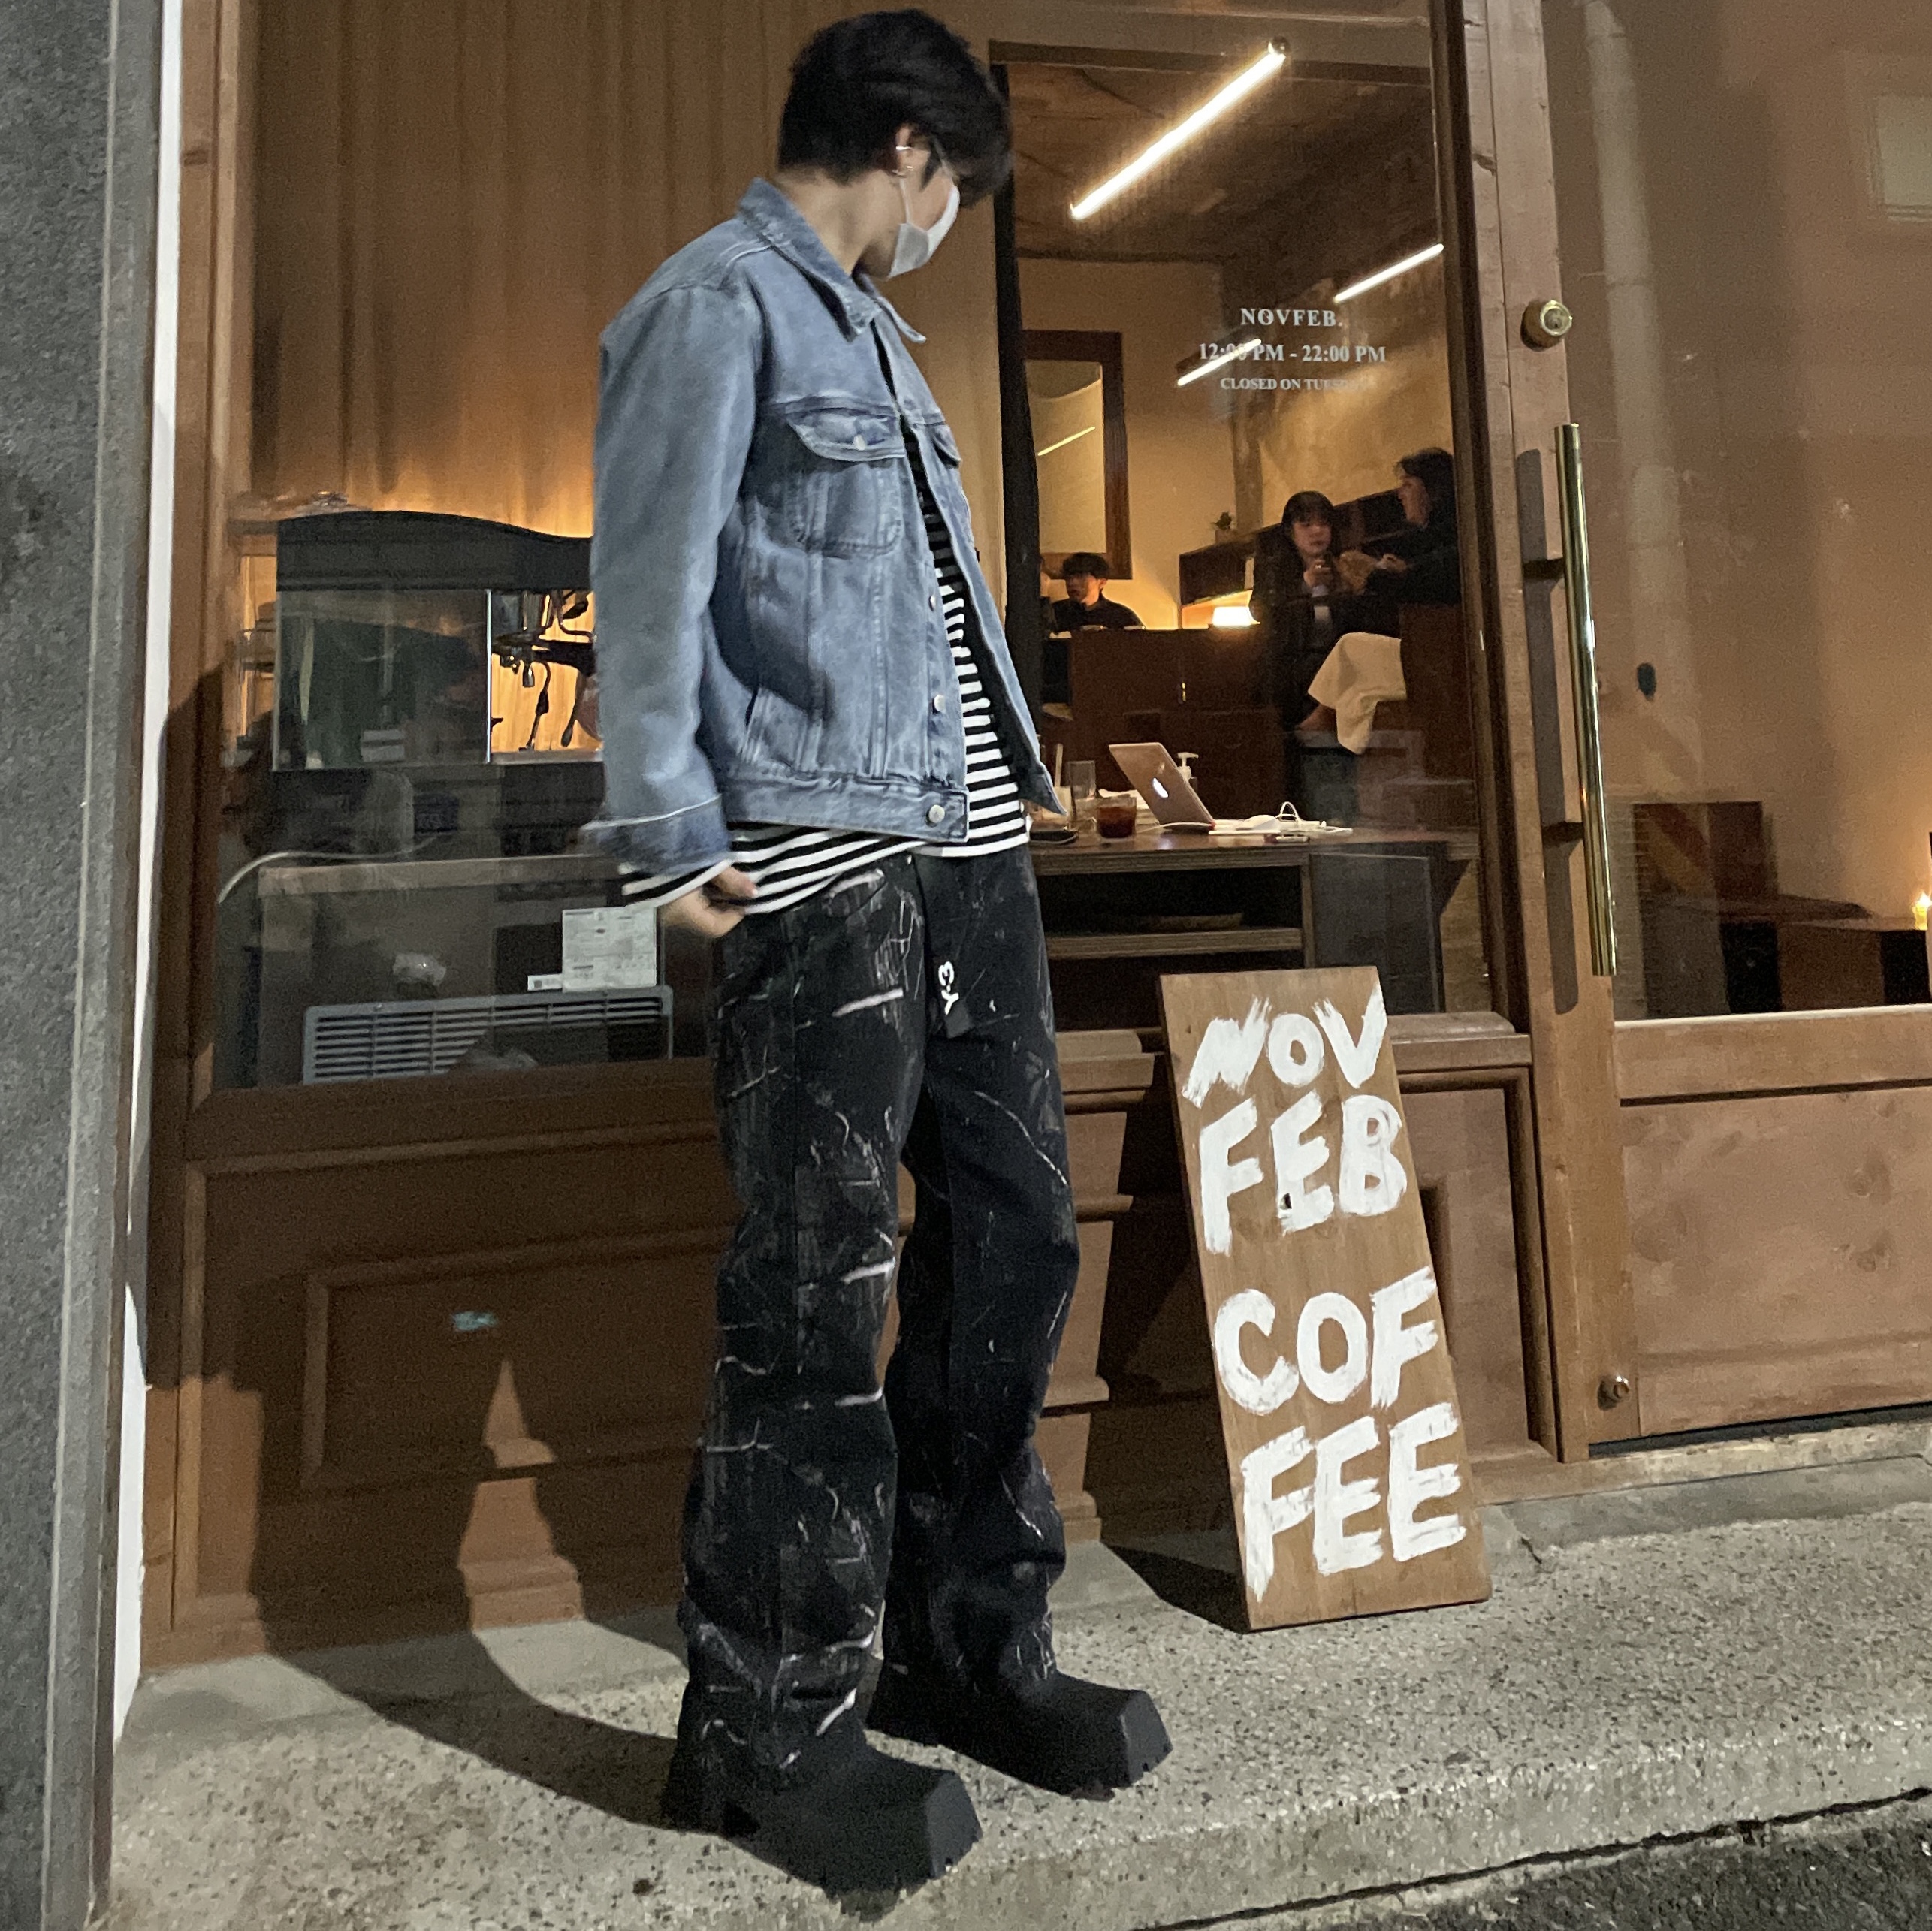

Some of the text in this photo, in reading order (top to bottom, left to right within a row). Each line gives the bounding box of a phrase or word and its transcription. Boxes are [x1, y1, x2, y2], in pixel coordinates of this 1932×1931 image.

[1220, 378, 1277, 390] CLOSED
[1280, 379, 1301, 390] ON
[1253, 344, 1284, 361] PM
[1302, 345, 1350, 362] 22:00
[1355, 345, 1386, 363] PM
[938, 961, 959, 1015] Y-3
[1182, 982, 1388, 1109] NOV
[1200, 1090, 1407, 1257] FEB
[1214, 1266, 1438, 1416] COF
[1240, 1402, 1466, 1602] FEE
